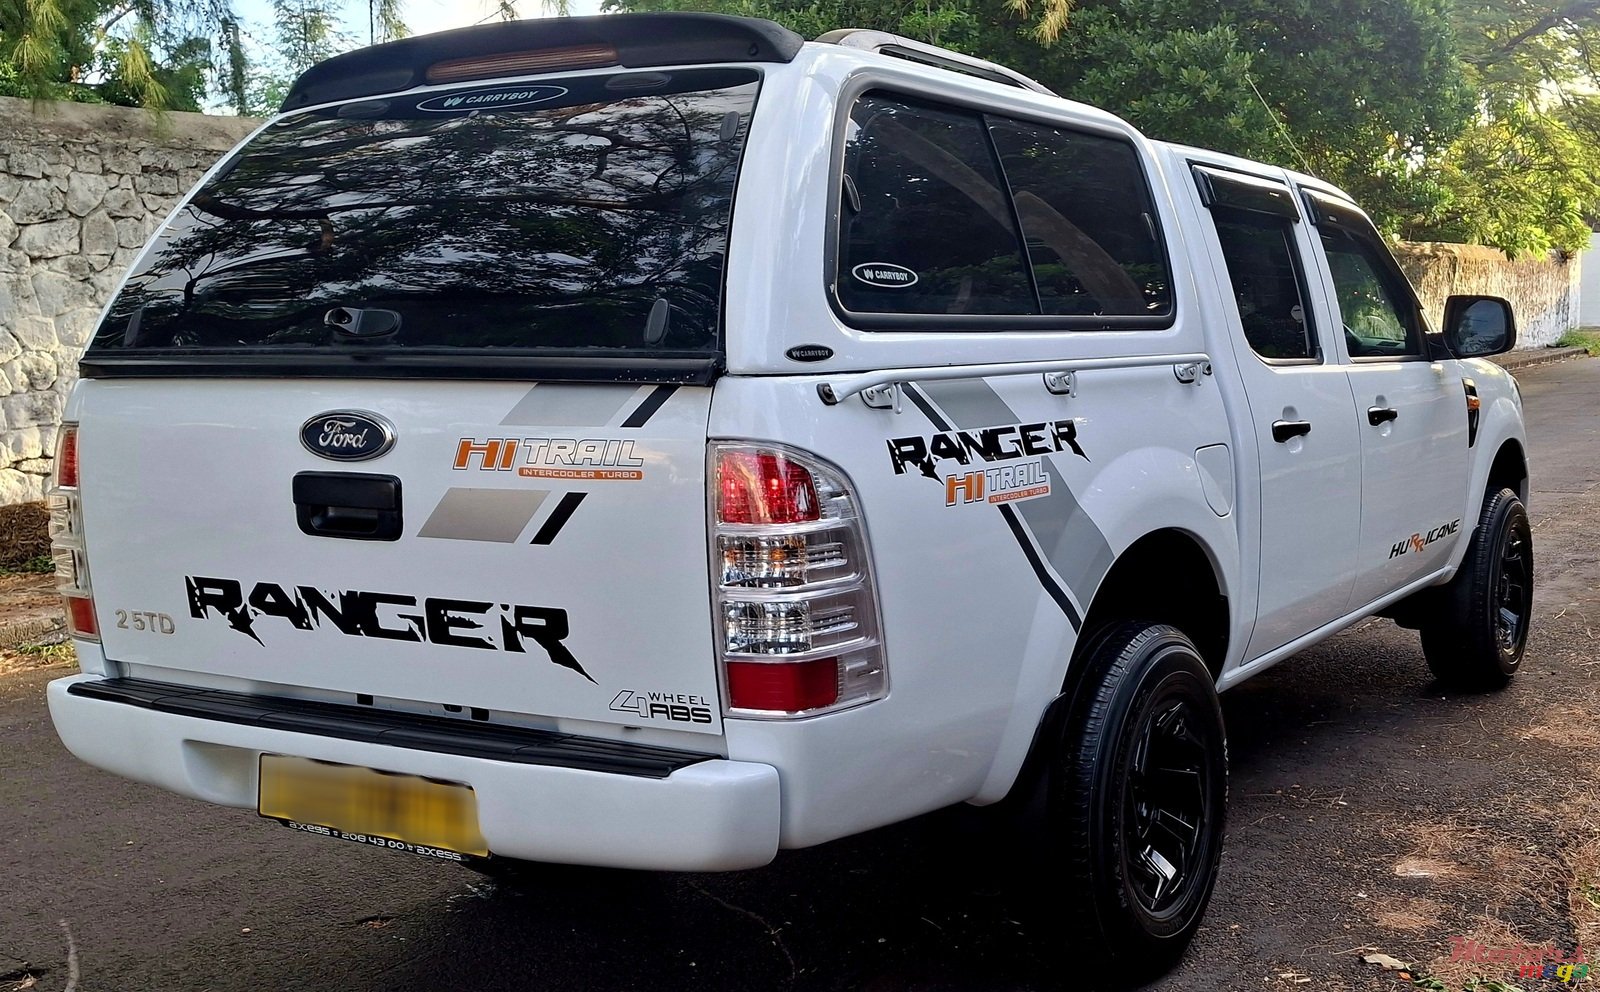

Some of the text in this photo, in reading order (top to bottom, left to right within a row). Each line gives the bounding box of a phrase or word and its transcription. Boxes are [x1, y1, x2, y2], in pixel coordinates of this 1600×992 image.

[466, 91, 539, 104] CARRYBOY
[875, 270, 908, 281] CARRYBOY
[801, 349, 829, 357] CARRYBOY
[318, 420, 367, 449] Ford
[452, 438, 645, 471] HI TRAIL
[886, 419, 1091, 486] RANGER
[523, 469, 638, 479] INTERCOOLER TURBO
[945, 461, 1047, 507] HI TRAIL
[990, 486, 1048, 502] INTERCOOLER TURBO
[1388, 518, 1461, 560] HURRICANE
[184, 575, 599, 685] RANGER
[609, 690, 711, 718] 4 WHEEL
[649, 703, 712, 724] ABS
[341, 831, 367, 843] 208
[368, 836, 386, 847] 43
[416, 845, 462, 861] axess
